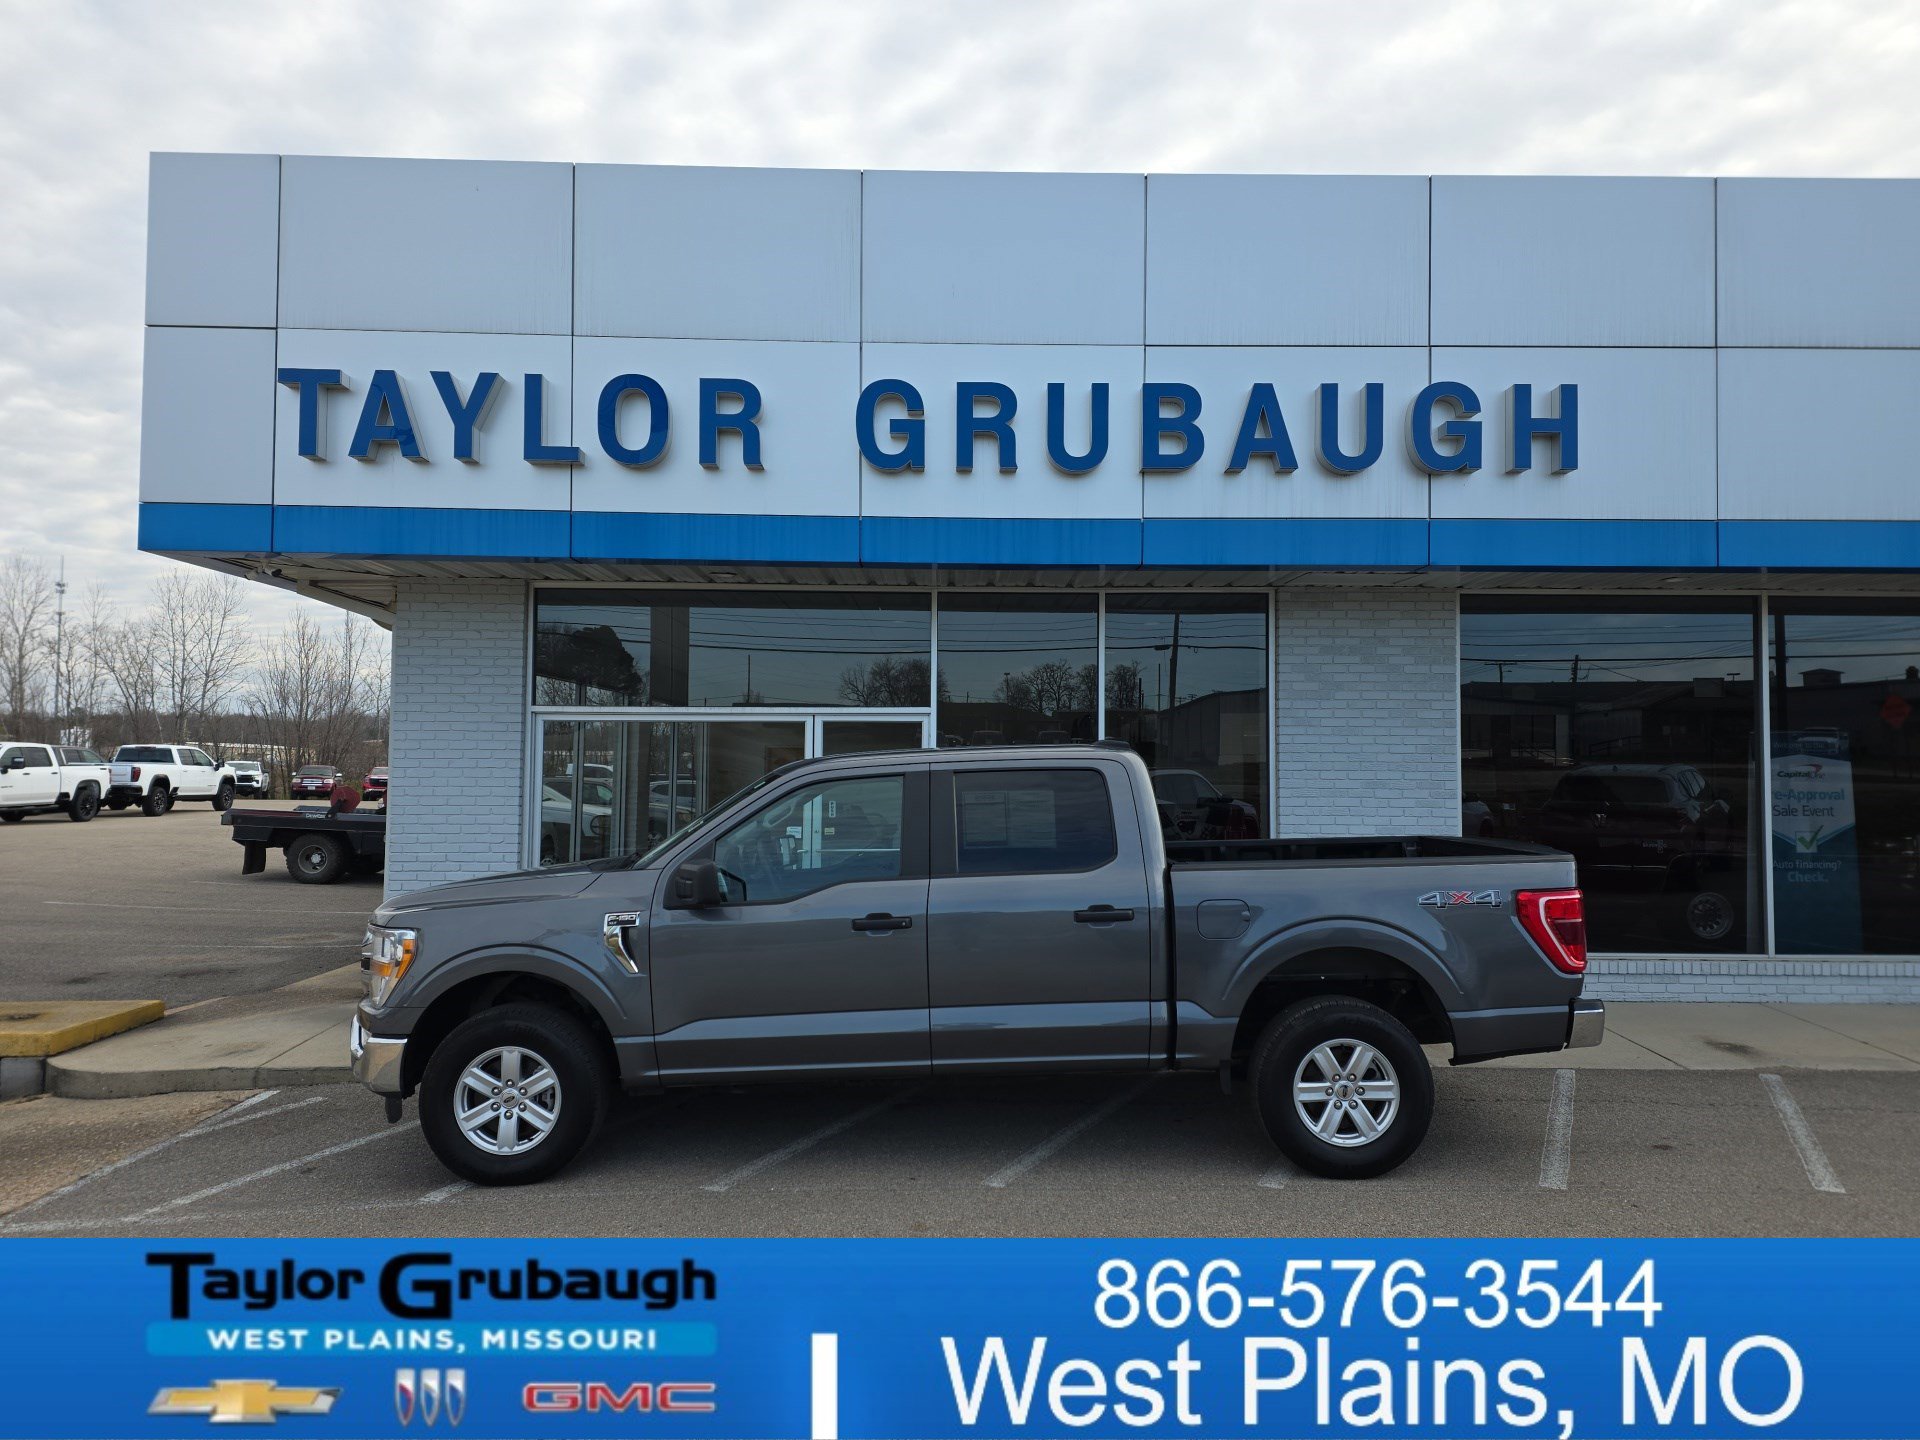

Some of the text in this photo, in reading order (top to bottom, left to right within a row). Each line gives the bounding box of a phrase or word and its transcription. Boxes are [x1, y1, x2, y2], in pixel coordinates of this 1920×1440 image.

[278, 368, 1579, 474] TAYLOR GRUBAUGH
[1773, 788, 1845, 803] e-Approval
[1773, 805, 1835, 817] Sale Event
[1773, 860, 1793, 869] Auto
[1787, 871, 1829, 883] Check.
